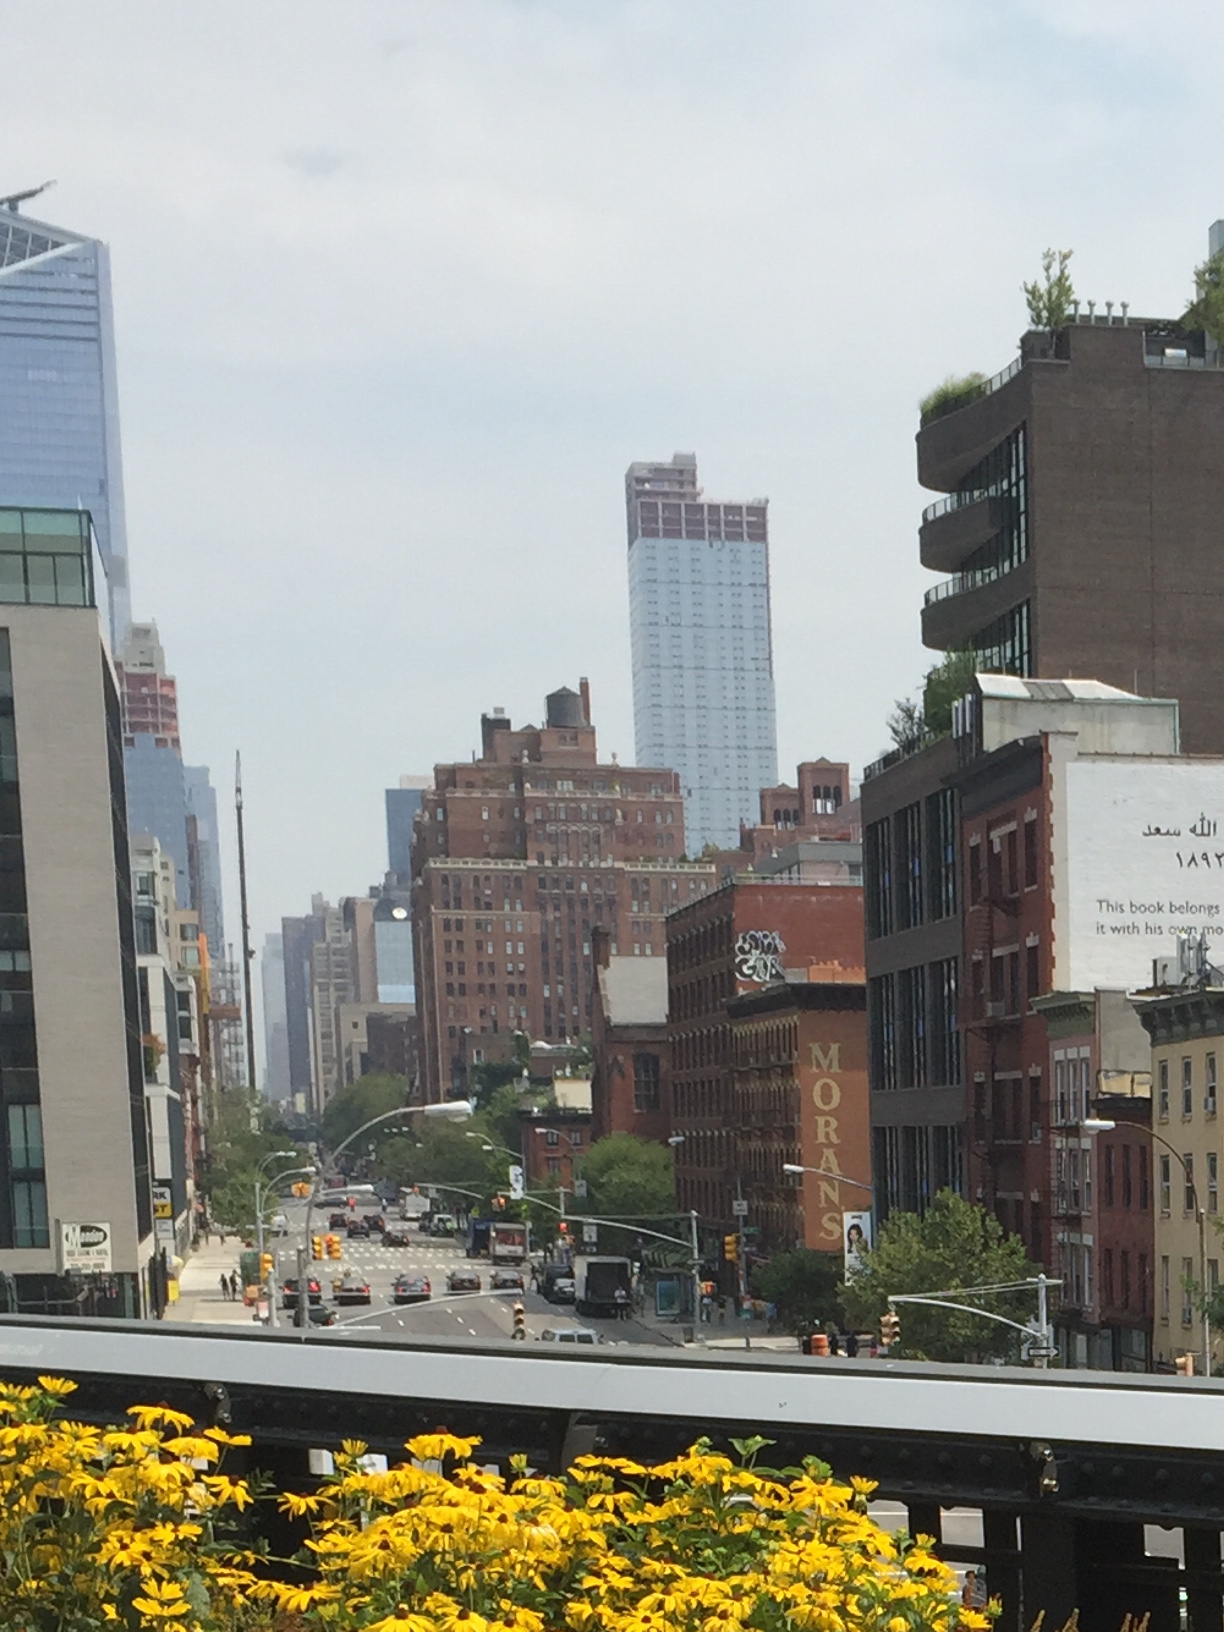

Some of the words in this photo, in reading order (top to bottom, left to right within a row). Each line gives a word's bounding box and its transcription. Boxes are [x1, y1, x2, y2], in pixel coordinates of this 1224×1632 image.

[1142, 824, 1181, 838] سعد
[1189, 812, 1217, 837] الله
[1176, 851, 1224, 869] ١٨٩٢
[1096, 899, 1125, 914] This
[1129, 900, 1164, 915] book
[1169, 901, 1220, 918] belongs
[1096, 921, 1106, 935] it
[1110, 921, 1140, 936] with
[1145, 921, 1164, 936] his
